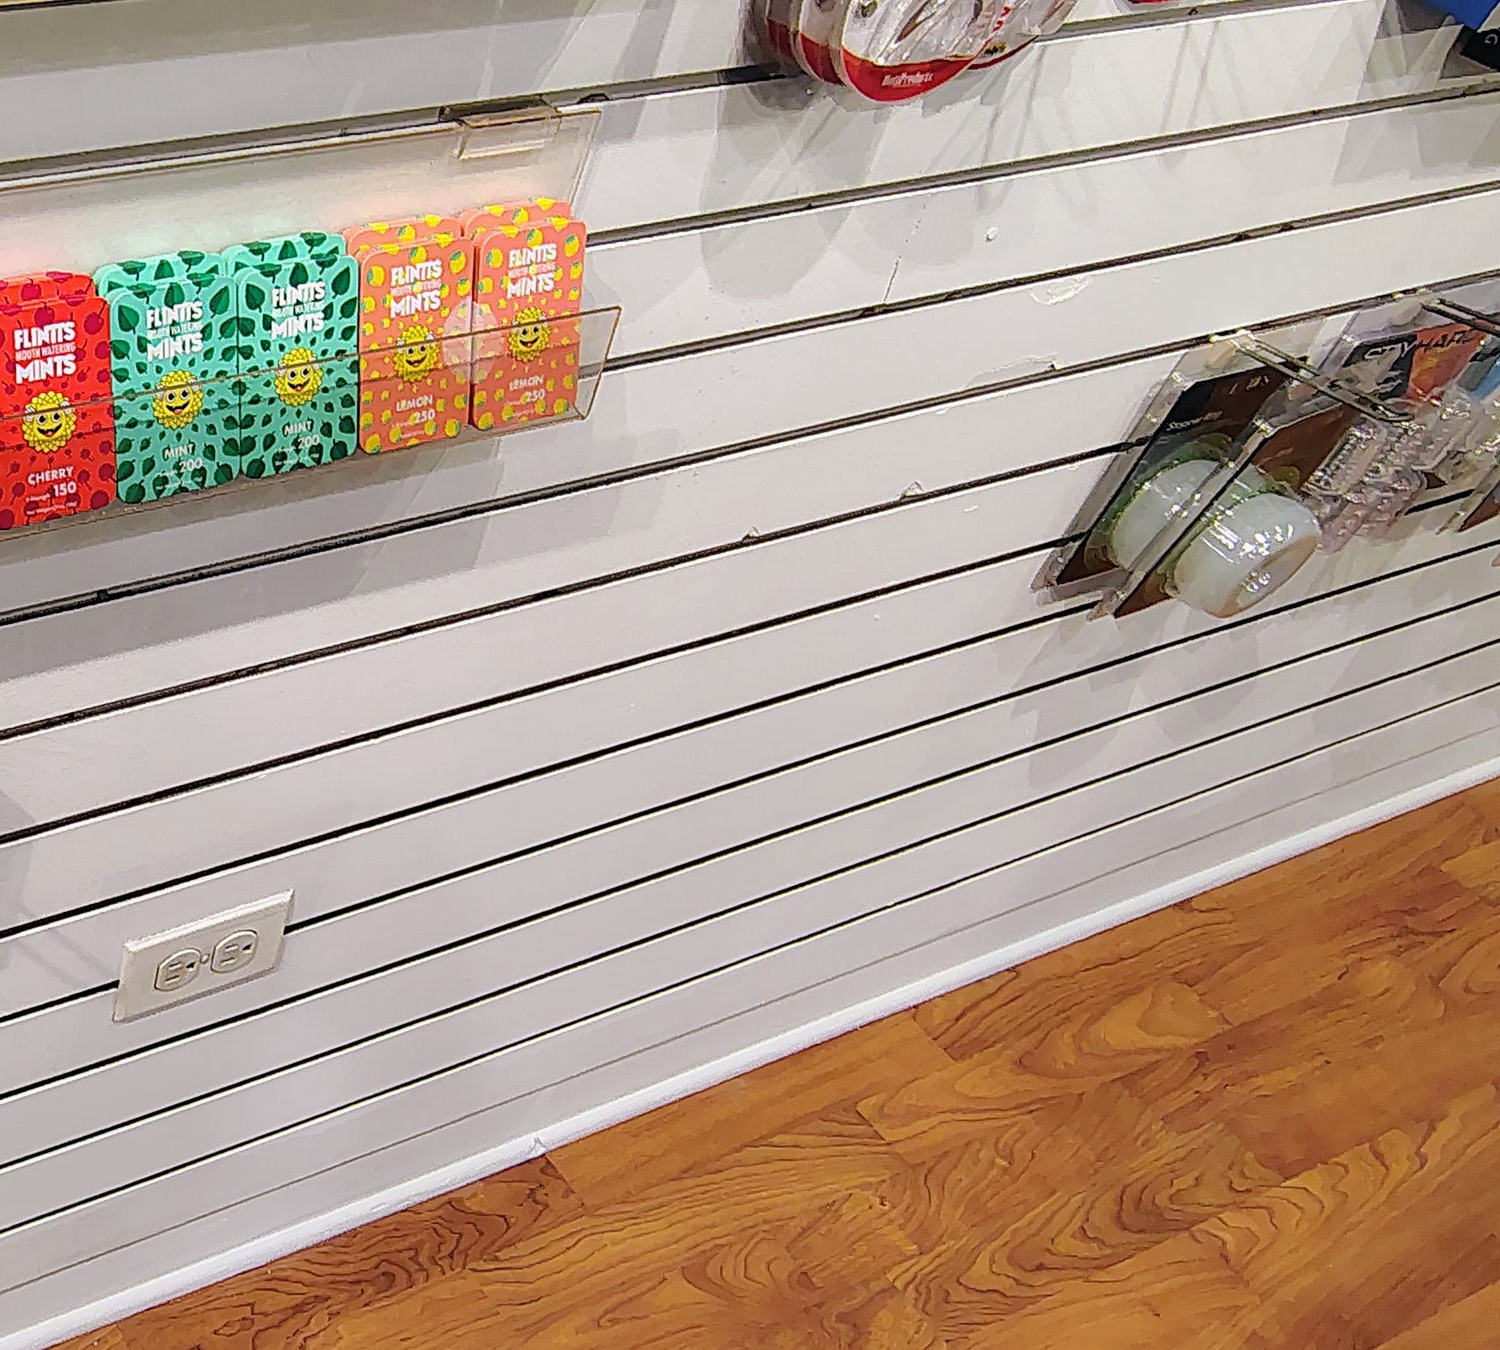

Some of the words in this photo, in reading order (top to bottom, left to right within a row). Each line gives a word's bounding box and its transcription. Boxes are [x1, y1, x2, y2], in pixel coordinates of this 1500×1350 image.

[506, 272, 555, 300] MINTS
[390, 290, 441, 319] MINTS
[271, 311, 325, 340] MINTS
[147, 333, 204, 362] MINTS
[15, 354, 76, 385] MINTS
[509, 375, 544, 391] LEMON
[395, 394, 434, 412] LEMON
[284, 420, 313, 435] MINT
[297, 433, 320, 449] 200
[164, 443, 195, 459] MINT
[179, 457, 204, 473] 200
[27, 465, 74, 486] CHERRY
[53, 481, 77, 497] 150
